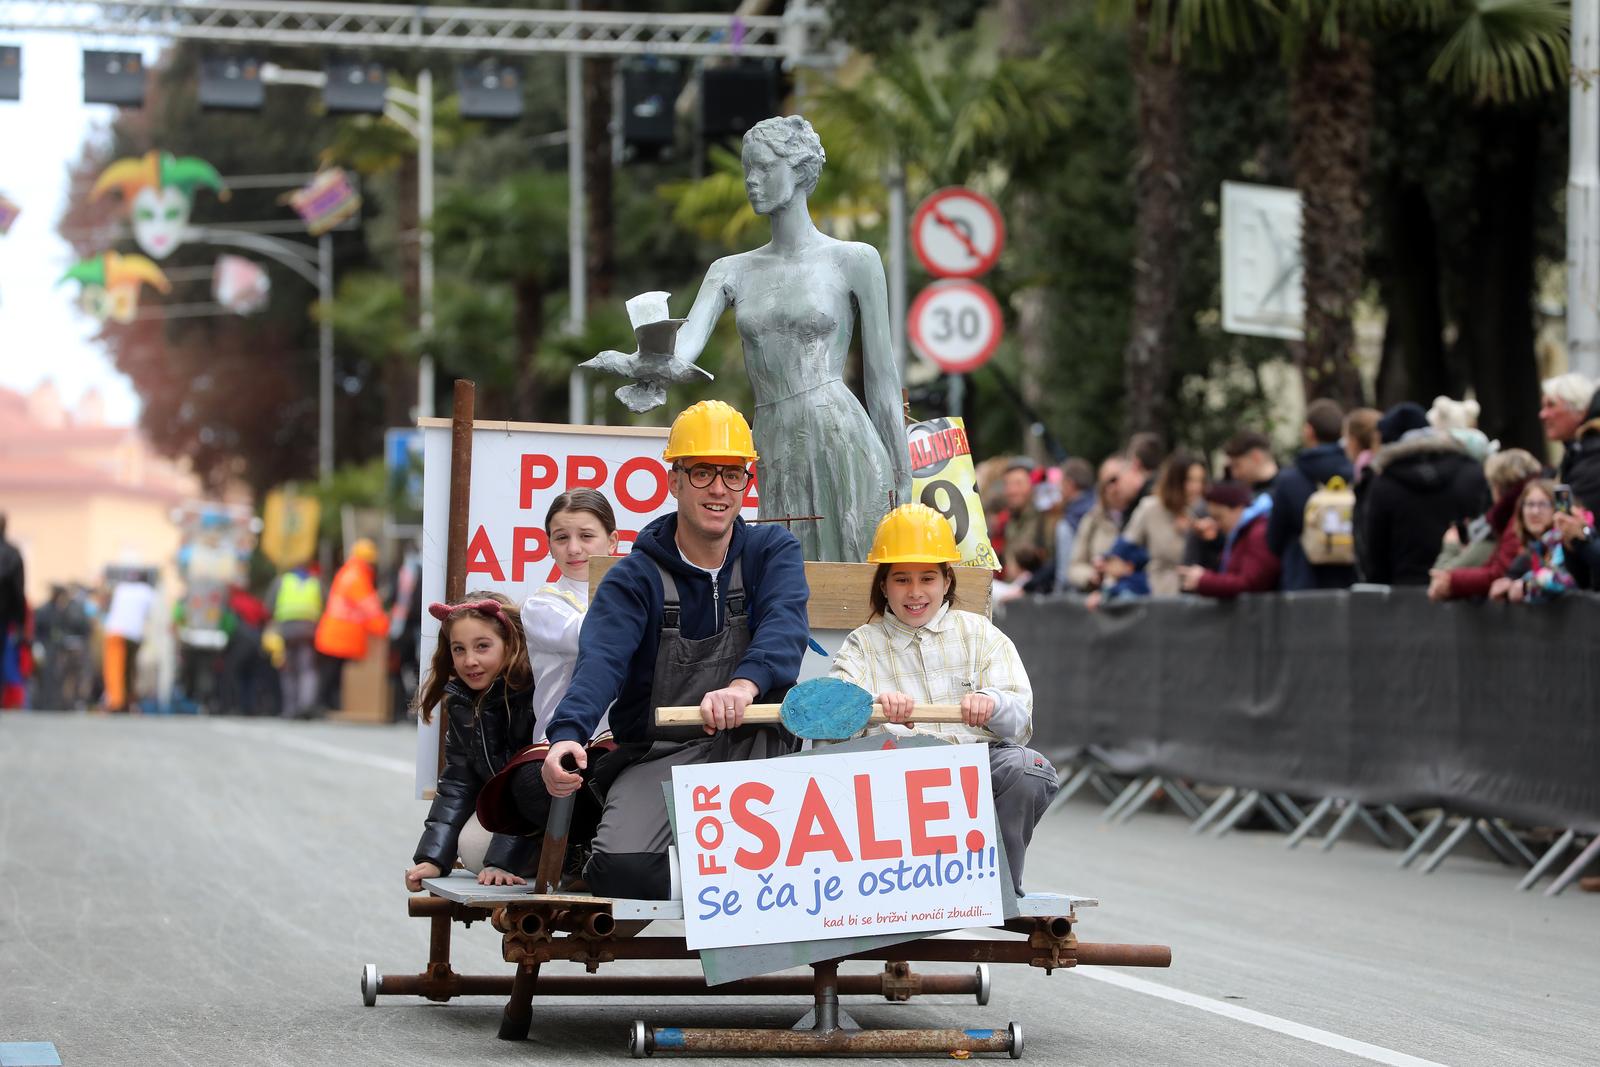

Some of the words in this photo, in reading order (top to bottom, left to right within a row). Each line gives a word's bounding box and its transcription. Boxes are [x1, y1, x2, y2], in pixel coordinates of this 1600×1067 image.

[932, 306, 980, 342] 30
[692, 784, 727, 875] FOR
[729, 765, 986, 871] SALE!
[698, 885, 742, 921] Se
[756, 873, 797, 911] ča
[805, 867, 844, 916] je
[858, 846, 997, 897] ostalo!!!
[823, 916, 844, 928] kad
[848, 914, 858, 926] bi
[861, 915, 872, 925] se
[876, 911, 908, 924] brižni
[911, 908, 944, 921] nonići
